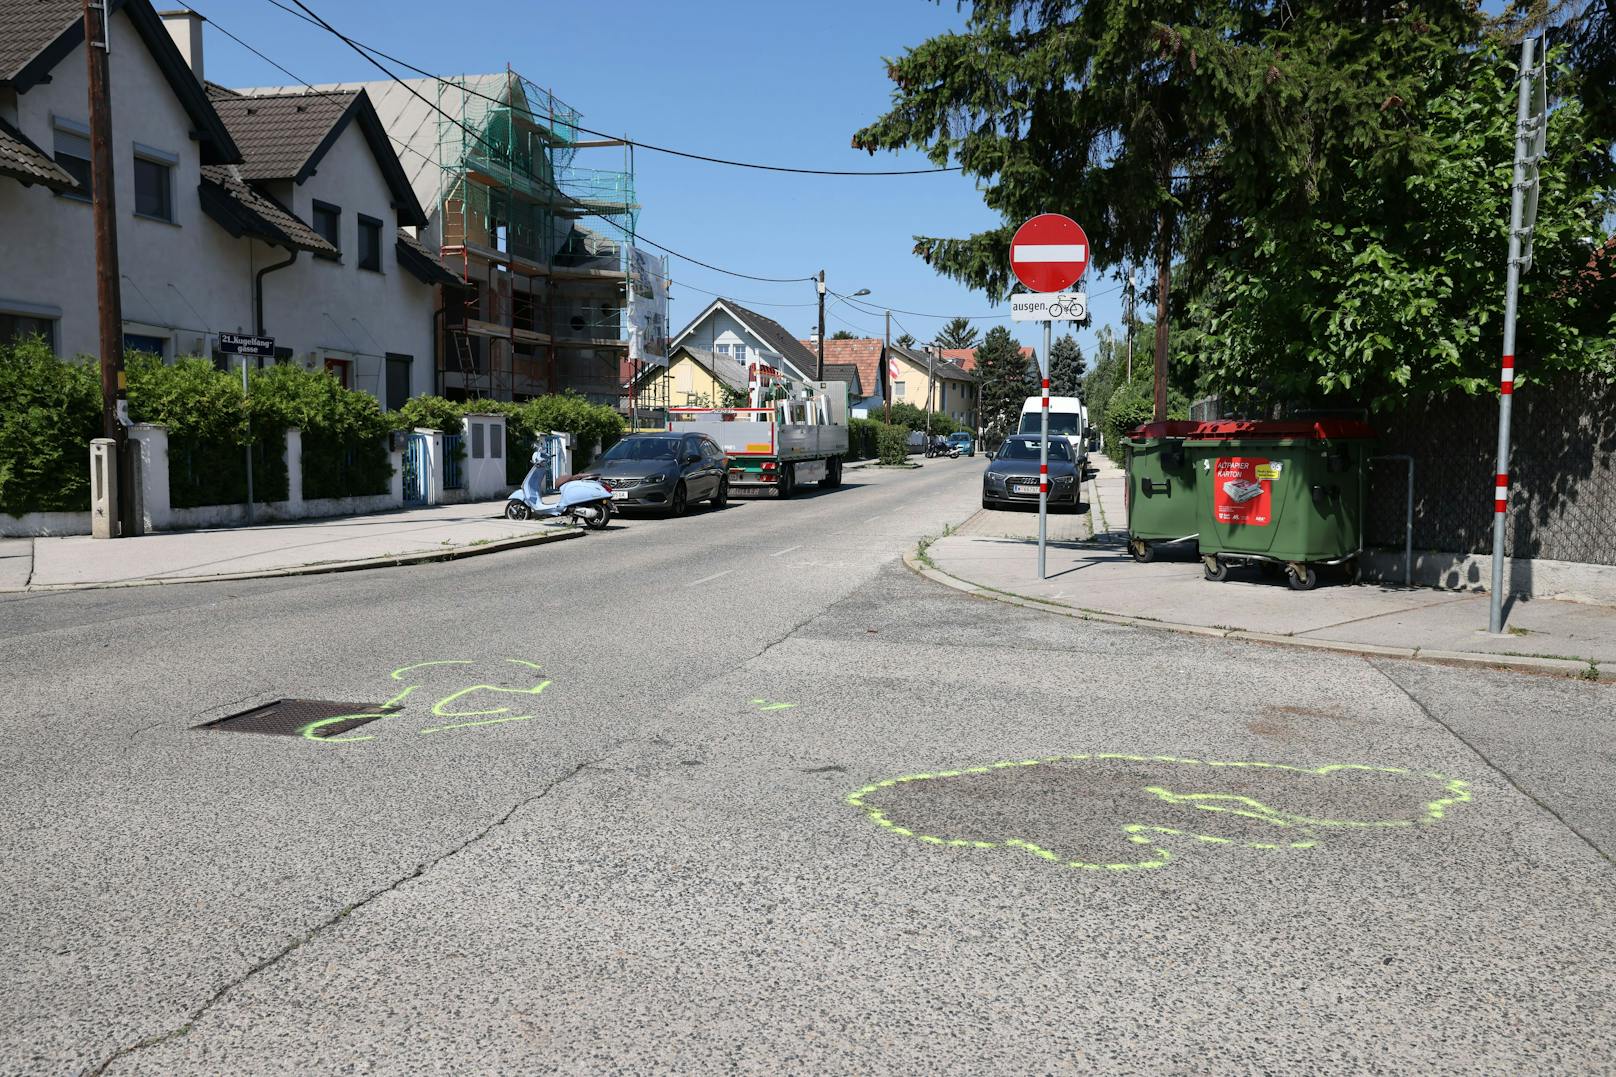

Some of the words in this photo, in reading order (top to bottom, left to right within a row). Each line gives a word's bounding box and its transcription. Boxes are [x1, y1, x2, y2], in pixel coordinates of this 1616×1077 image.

[1012, 302, 1048, 312] ausgen.
[237, 346, 259, 354] gasse
[1218, 462, 1249, 470] ALTPAPIER
